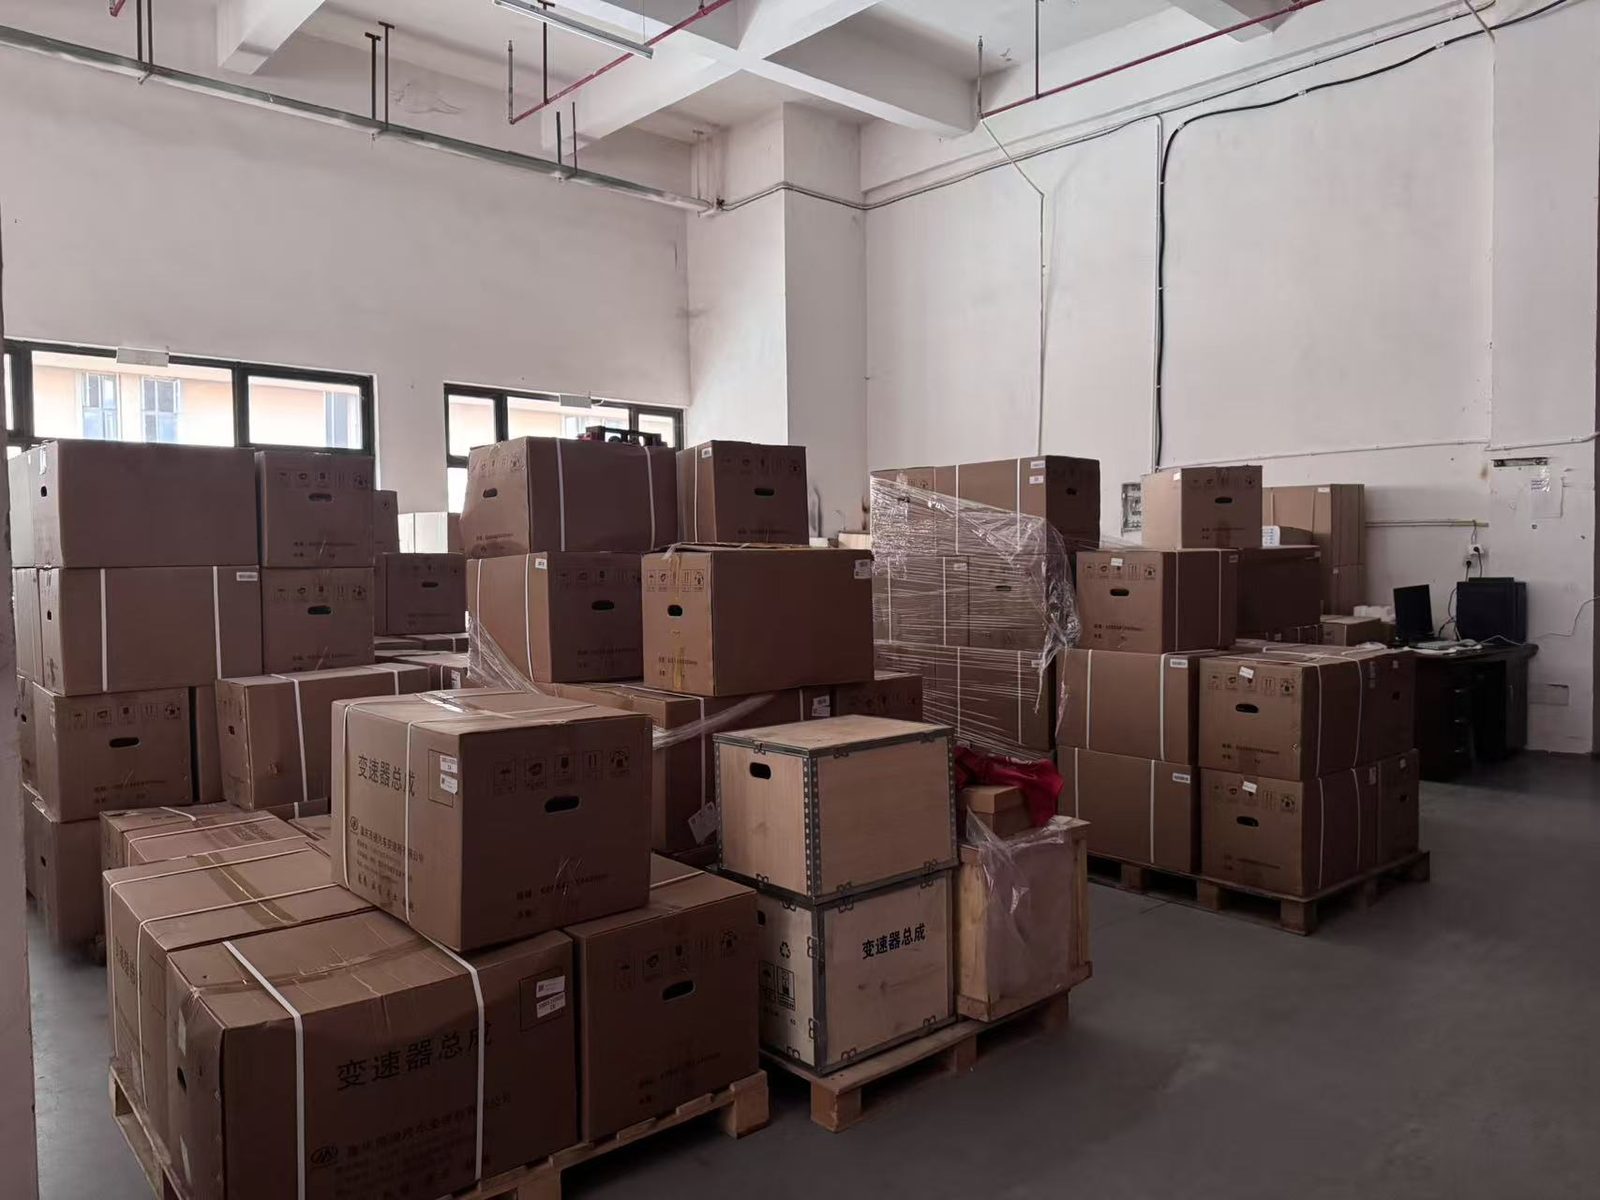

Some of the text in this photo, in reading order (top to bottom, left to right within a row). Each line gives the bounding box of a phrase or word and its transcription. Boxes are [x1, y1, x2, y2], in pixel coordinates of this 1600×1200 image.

[357, 754, 416, 798] 变速器总成
[862, 922, 926, 960] 变速器总成
[337, 1022, 493, 1091] 变速器总成
